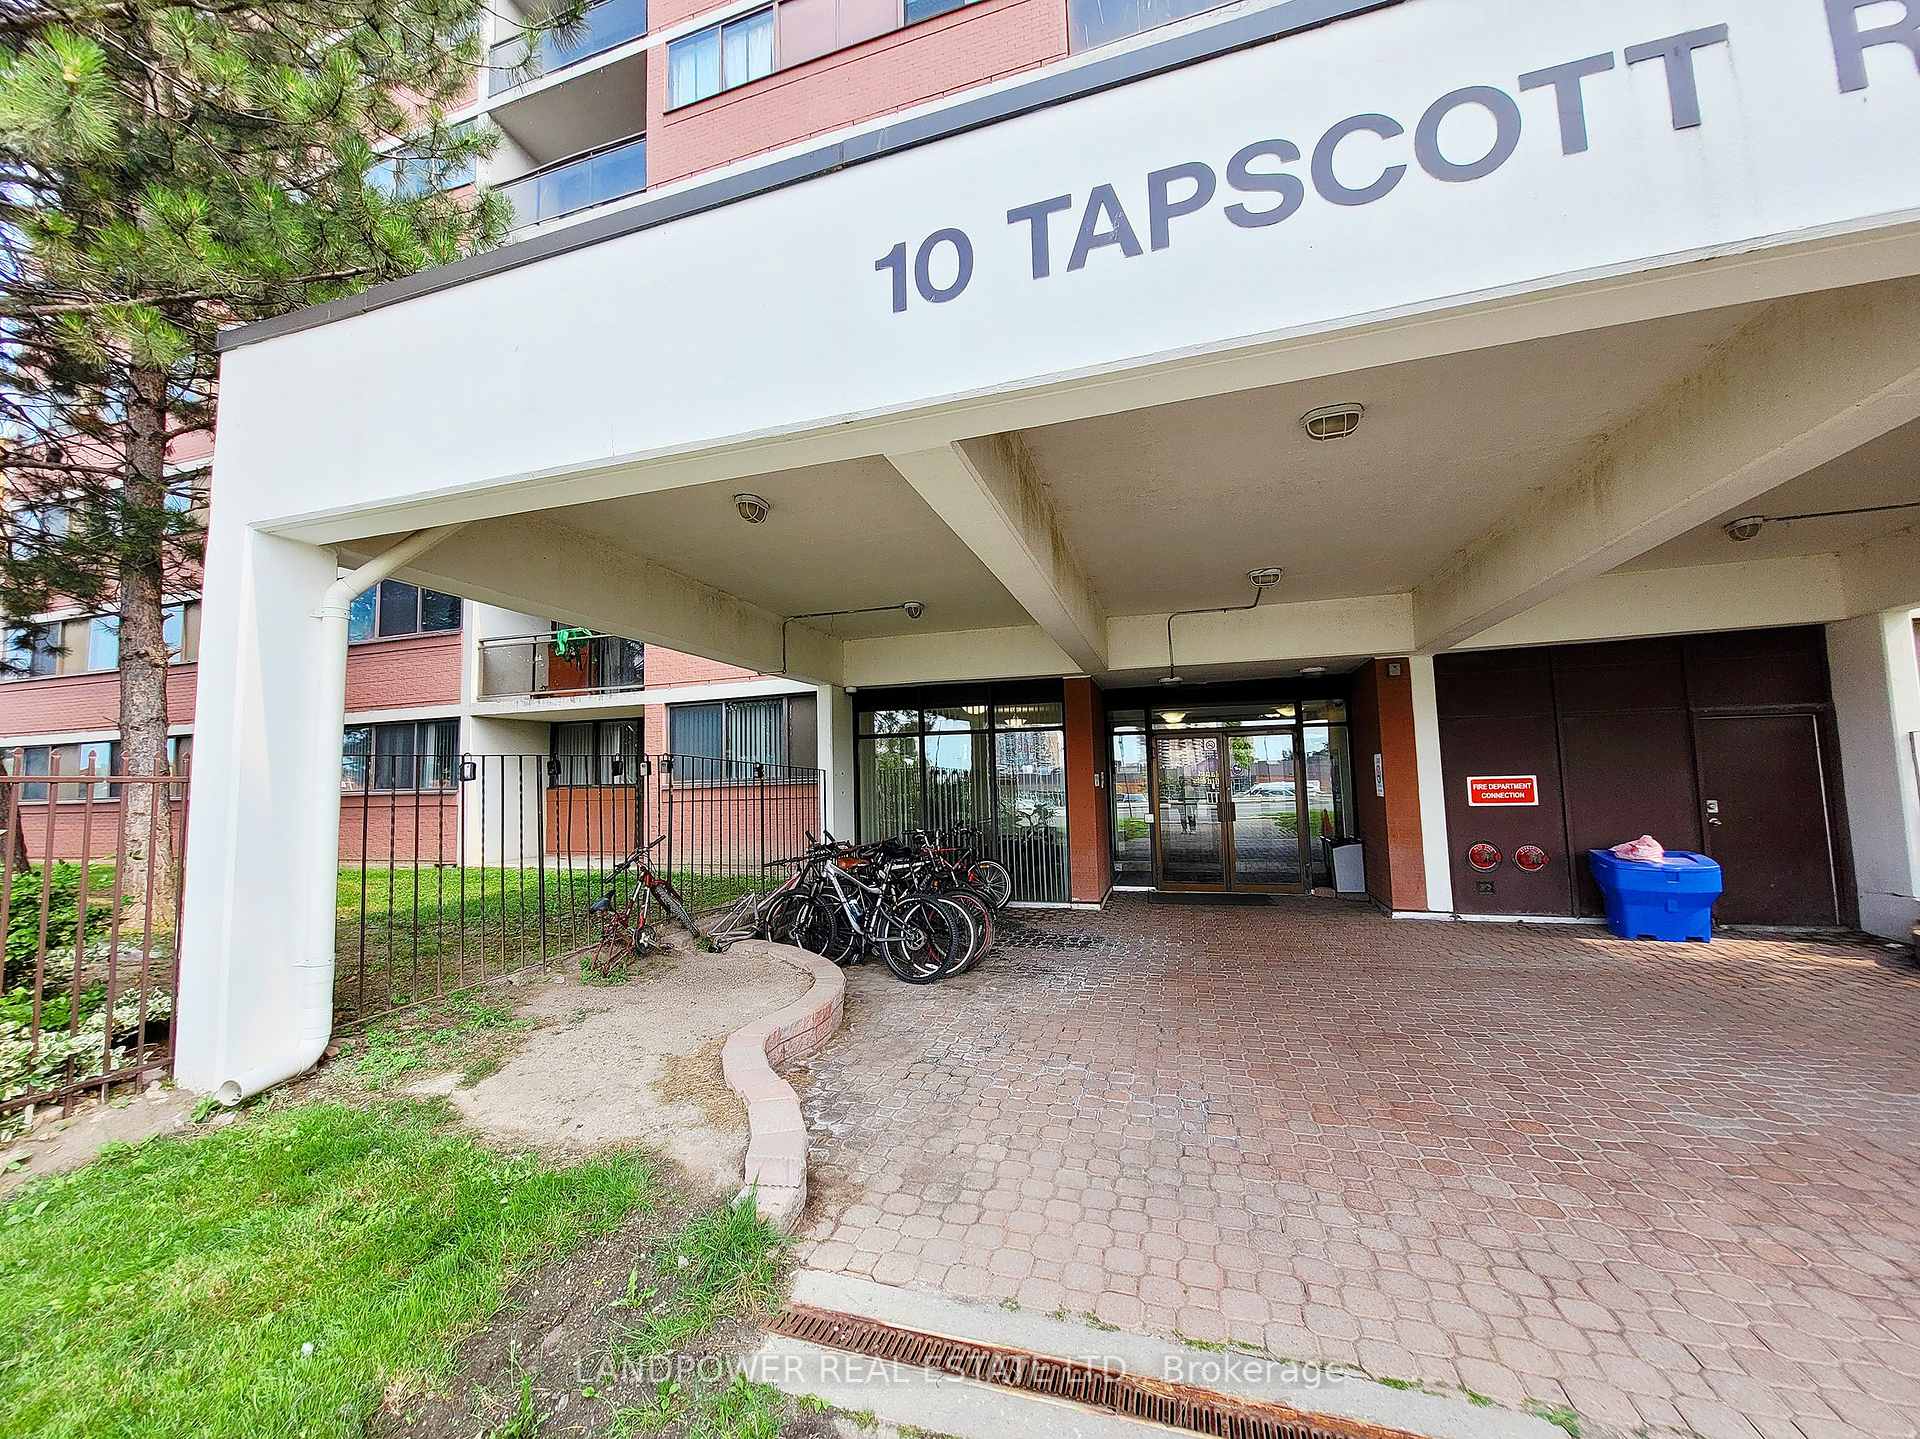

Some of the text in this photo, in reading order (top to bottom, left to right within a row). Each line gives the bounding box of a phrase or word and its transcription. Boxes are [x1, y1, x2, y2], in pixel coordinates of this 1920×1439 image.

[875, 227, 974, 314] 10
[1007, 24, 1728, 281] TAPSCOTT
[1489, 782, 1532, 790] DEPARTMENT
